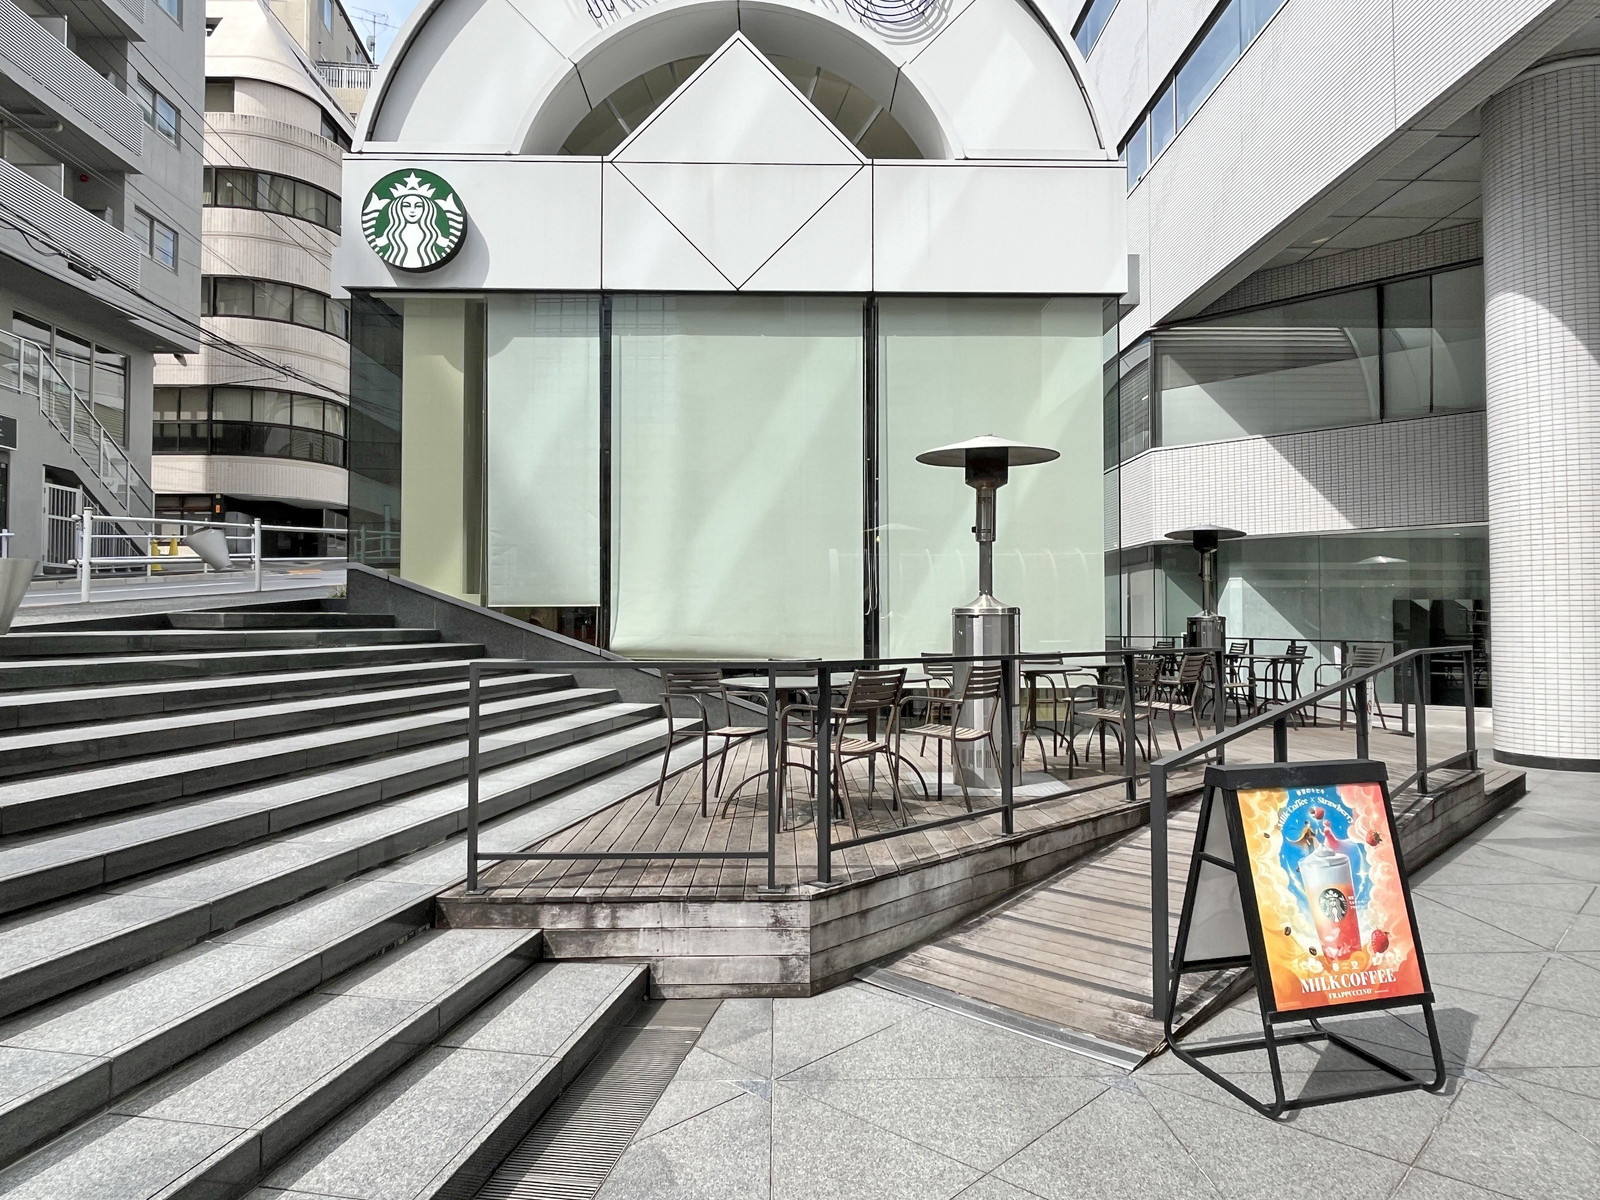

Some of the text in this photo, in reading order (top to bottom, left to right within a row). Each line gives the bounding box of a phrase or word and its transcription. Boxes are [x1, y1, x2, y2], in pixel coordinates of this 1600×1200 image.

[1287, 797, 1309, 812] Coffee
[1317, 797, 1354, 824] Strawberry
[1301, 968, 1396, 994] MILK COFFEE
